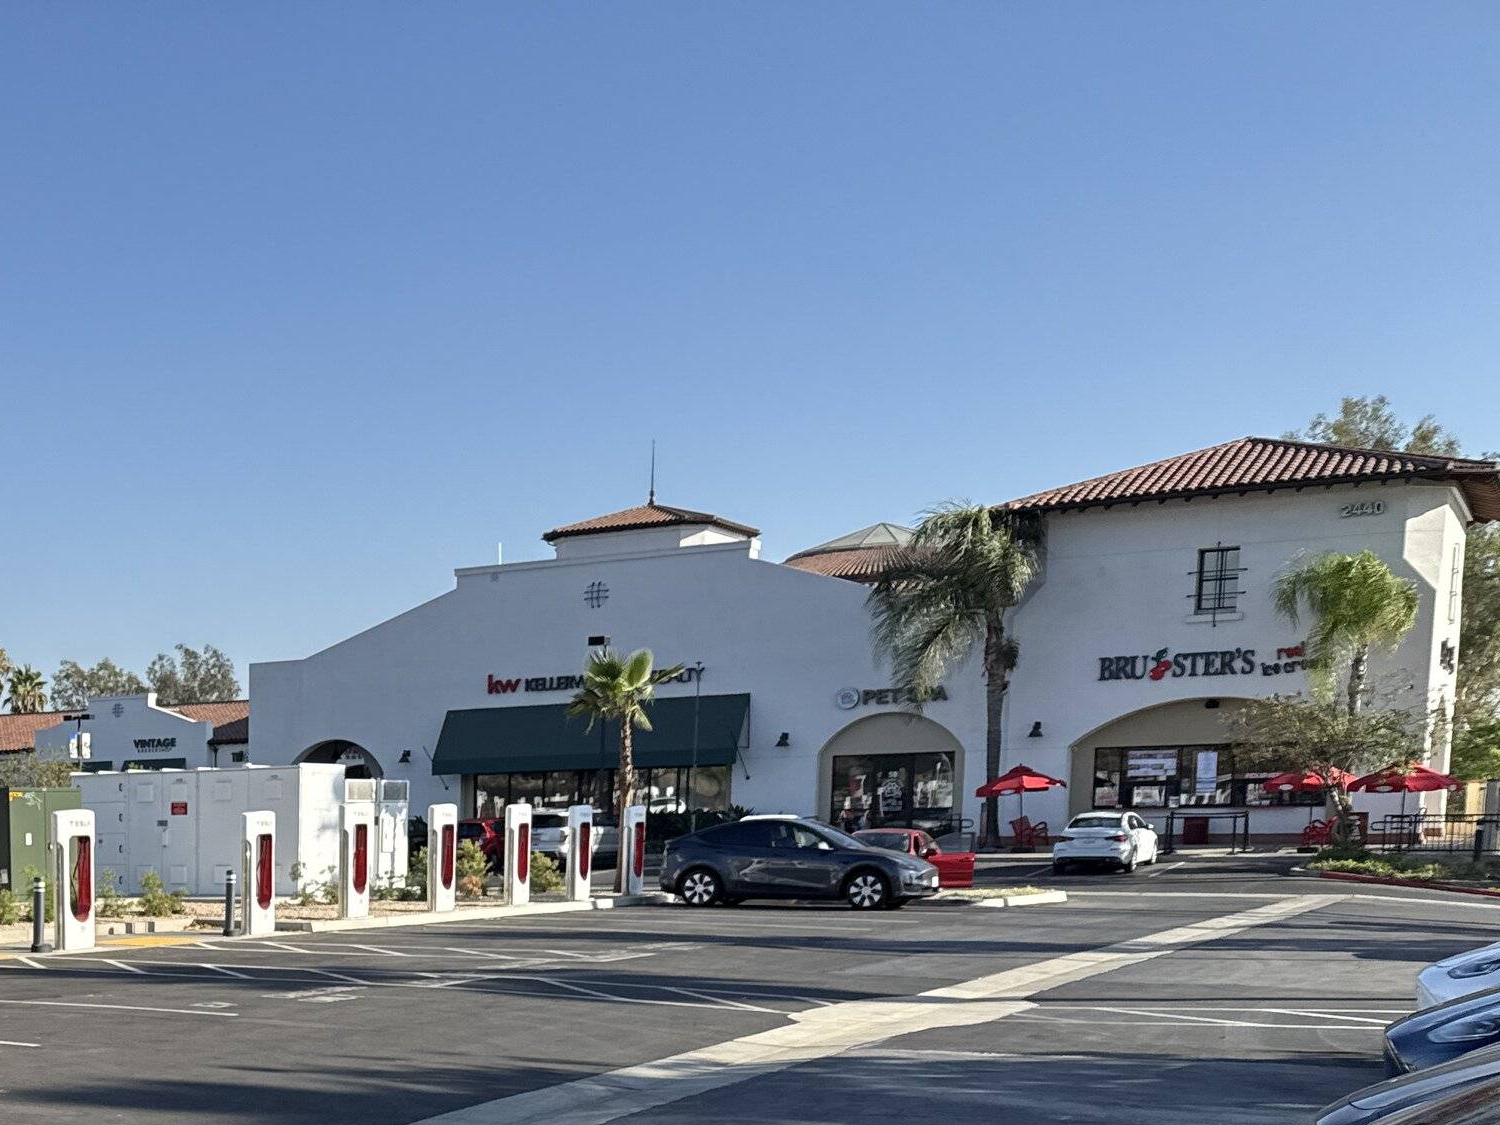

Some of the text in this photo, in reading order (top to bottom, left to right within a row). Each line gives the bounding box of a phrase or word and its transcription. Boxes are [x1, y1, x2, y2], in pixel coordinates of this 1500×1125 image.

[1340, 501, 1385, 518] 2440
[1276, 641, 1307, 660] real
[487, 674, 522, 695] kw
[861, 684, 949, 705] PET SA
[133, 737, 177, 749] VINTAGE
